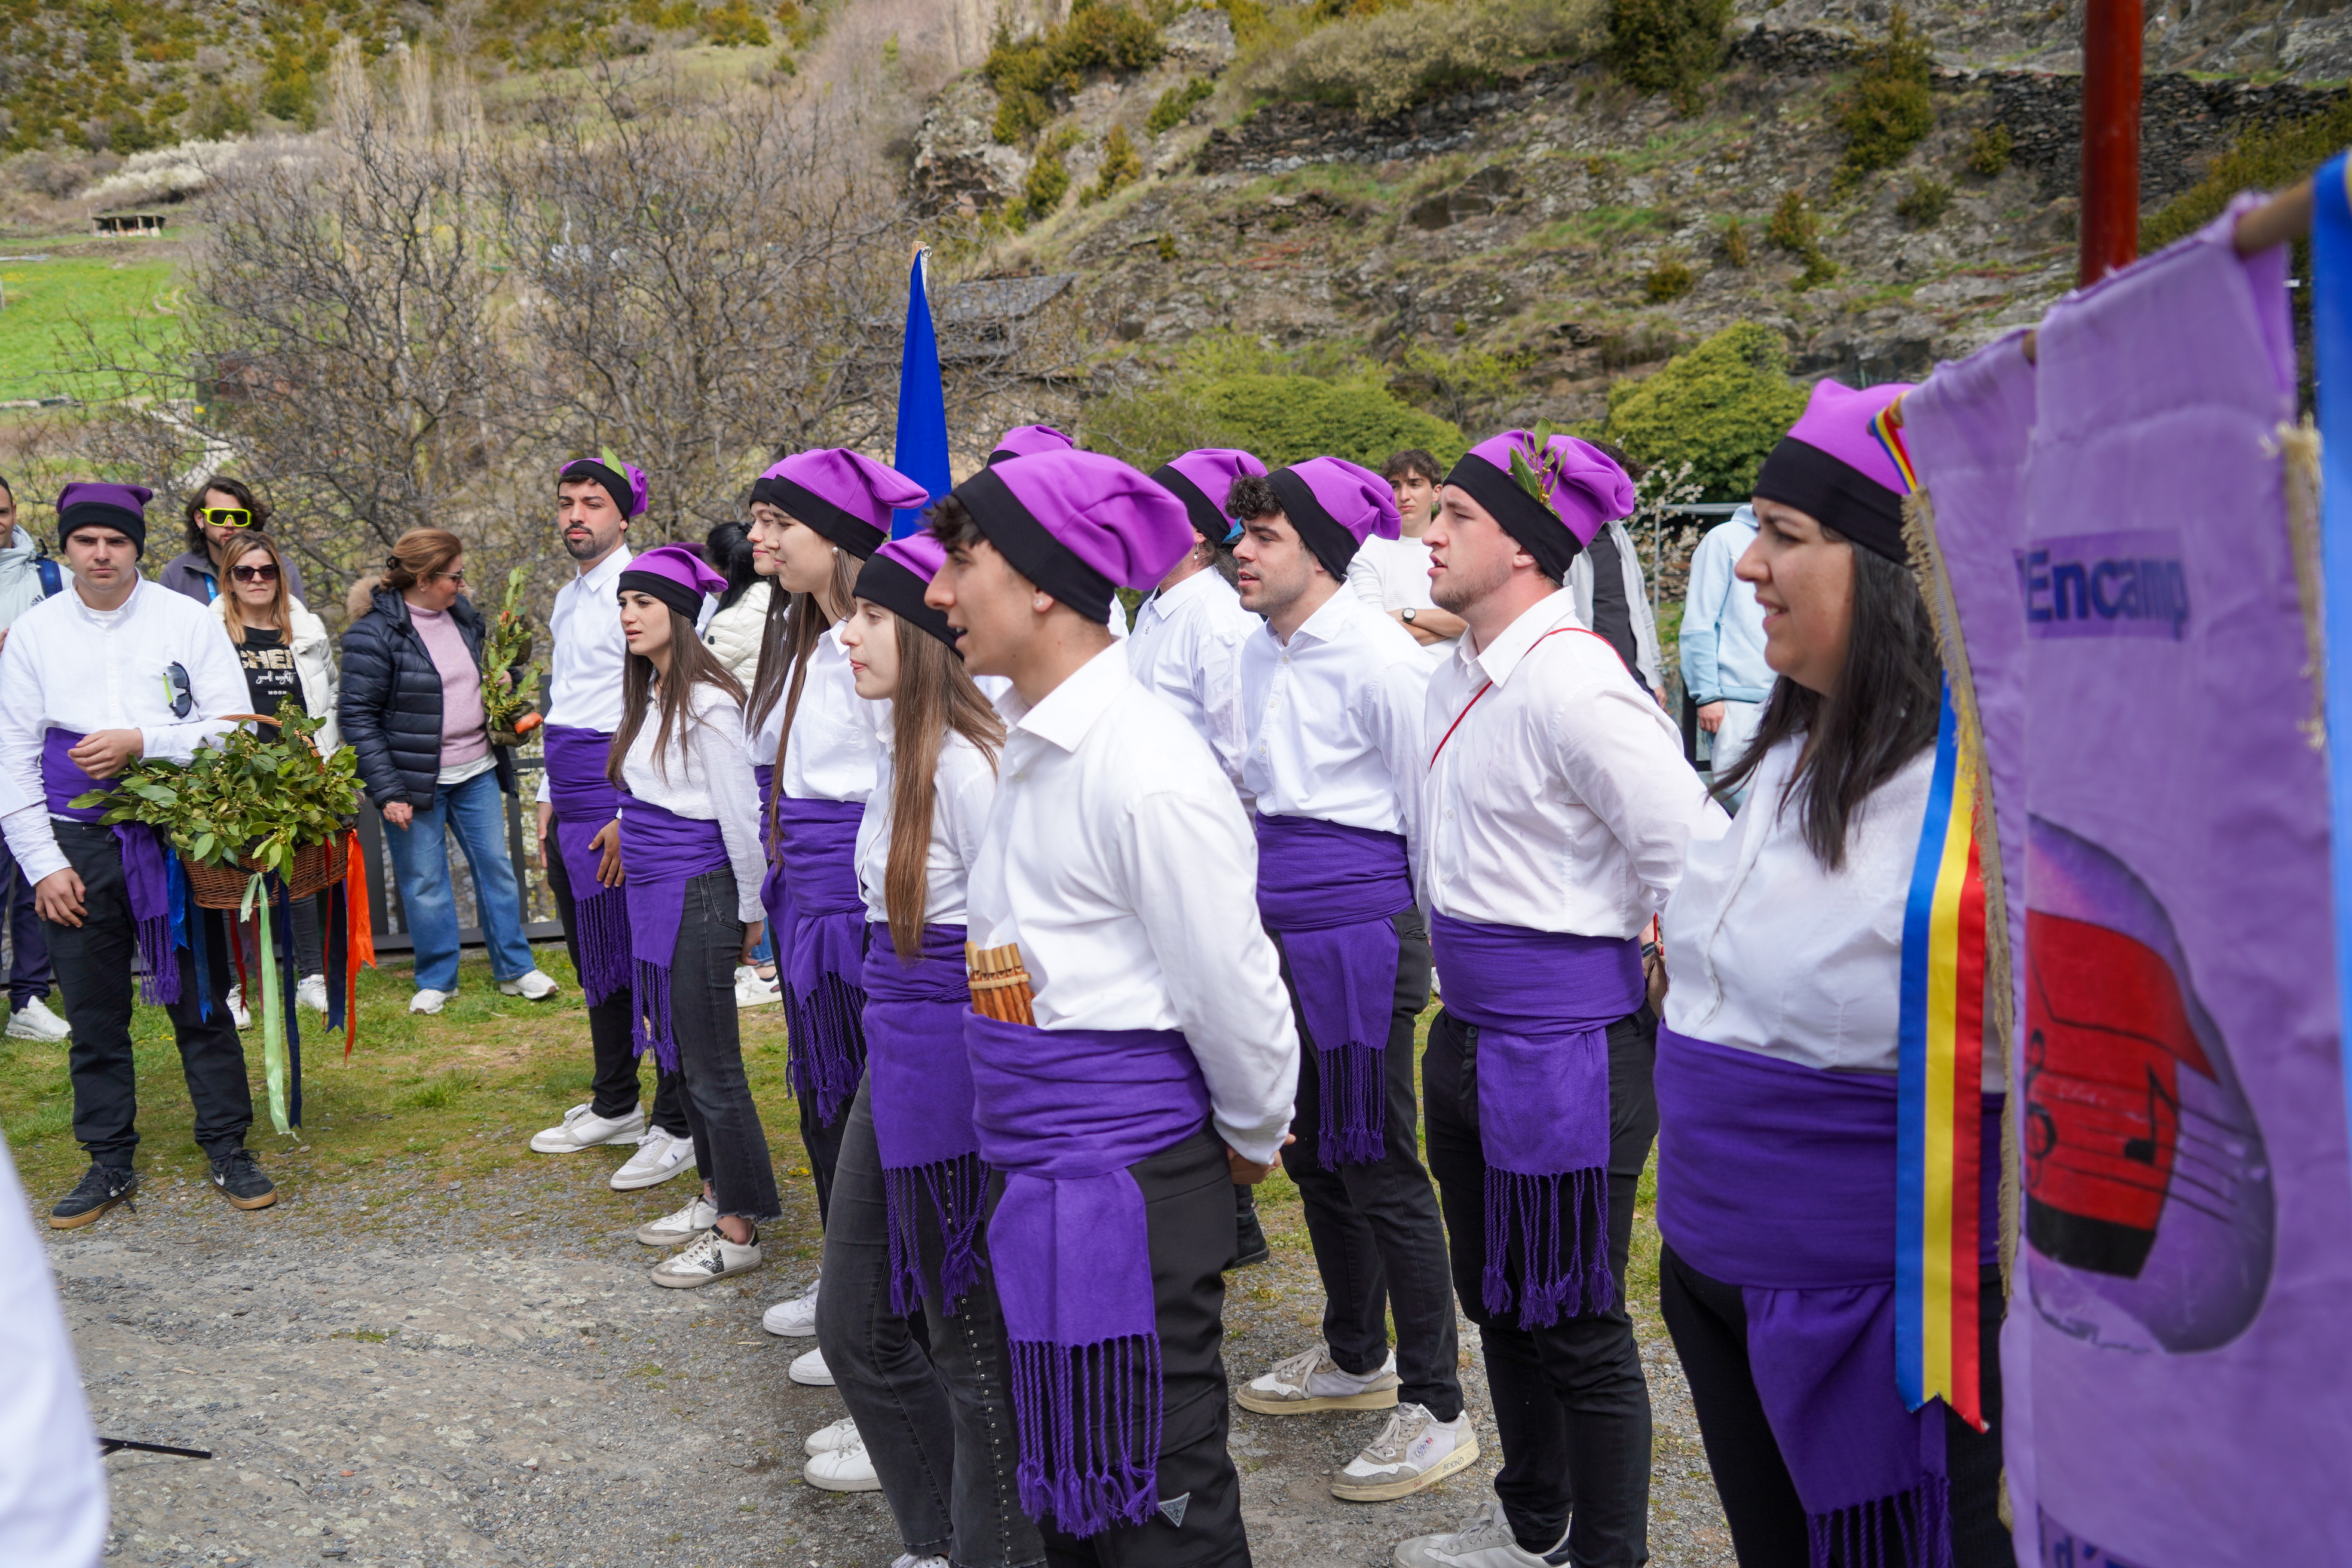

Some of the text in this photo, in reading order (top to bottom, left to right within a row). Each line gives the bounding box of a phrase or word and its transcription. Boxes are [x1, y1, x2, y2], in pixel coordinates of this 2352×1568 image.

[256, 670, 296, 685] good night
[1417, 1441, 1427, 1456] AUTRY
[1413, 1455, 1464, 1488] ONE BEYOND
[1165, 1499, 1186, 1510] GUESS
